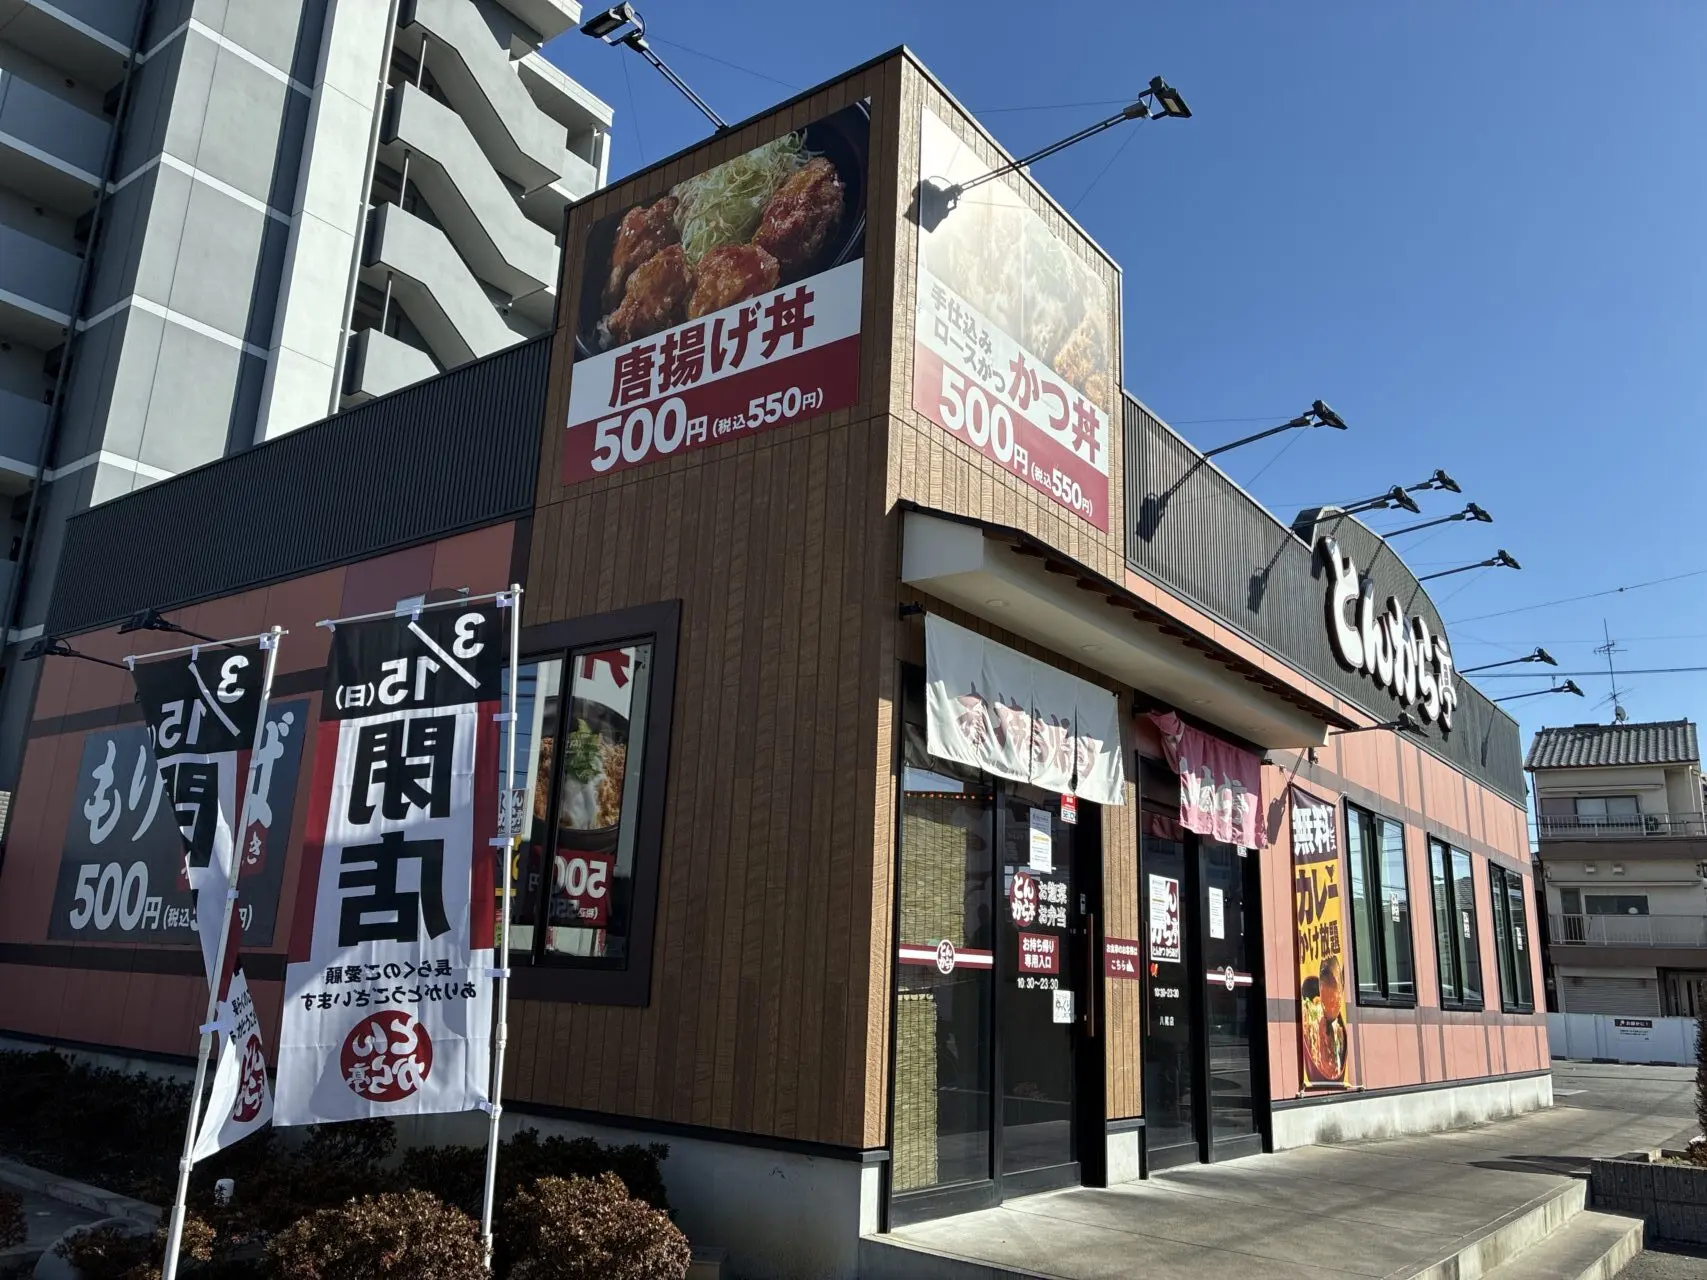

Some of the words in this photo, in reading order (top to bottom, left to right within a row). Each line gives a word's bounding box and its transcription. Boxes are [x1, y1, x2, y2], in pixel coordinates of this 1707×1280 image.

[608, 284, 815, 409] 唐揚げ丼
[930, 282, 992, 355] 手仕込み
[934, 316, 1006, 394] ロースかつ
[590, 396, 708, 472] 500円
[712, 386, 824, 438] (税込550円)
[939, 363, 1029, 478] 500円
[1007, 351, 1102, 464] かつ丼
[1323, 536, 1458, 732] とんから亭
[1292, 803, 1331, 856] 無料
[69, 861, 163, 931] 500円
[1013, 874, 1034, 900] とん
[1038, 905, 1068, 929] お弁当
[1296, 868, 1339, 925] カレー
[1022, 937, 1056, 953] お持ち帰り
[1024, 953, 1053, 969] 専用入口
[1299, 919, 1341, 965] かけ放題
